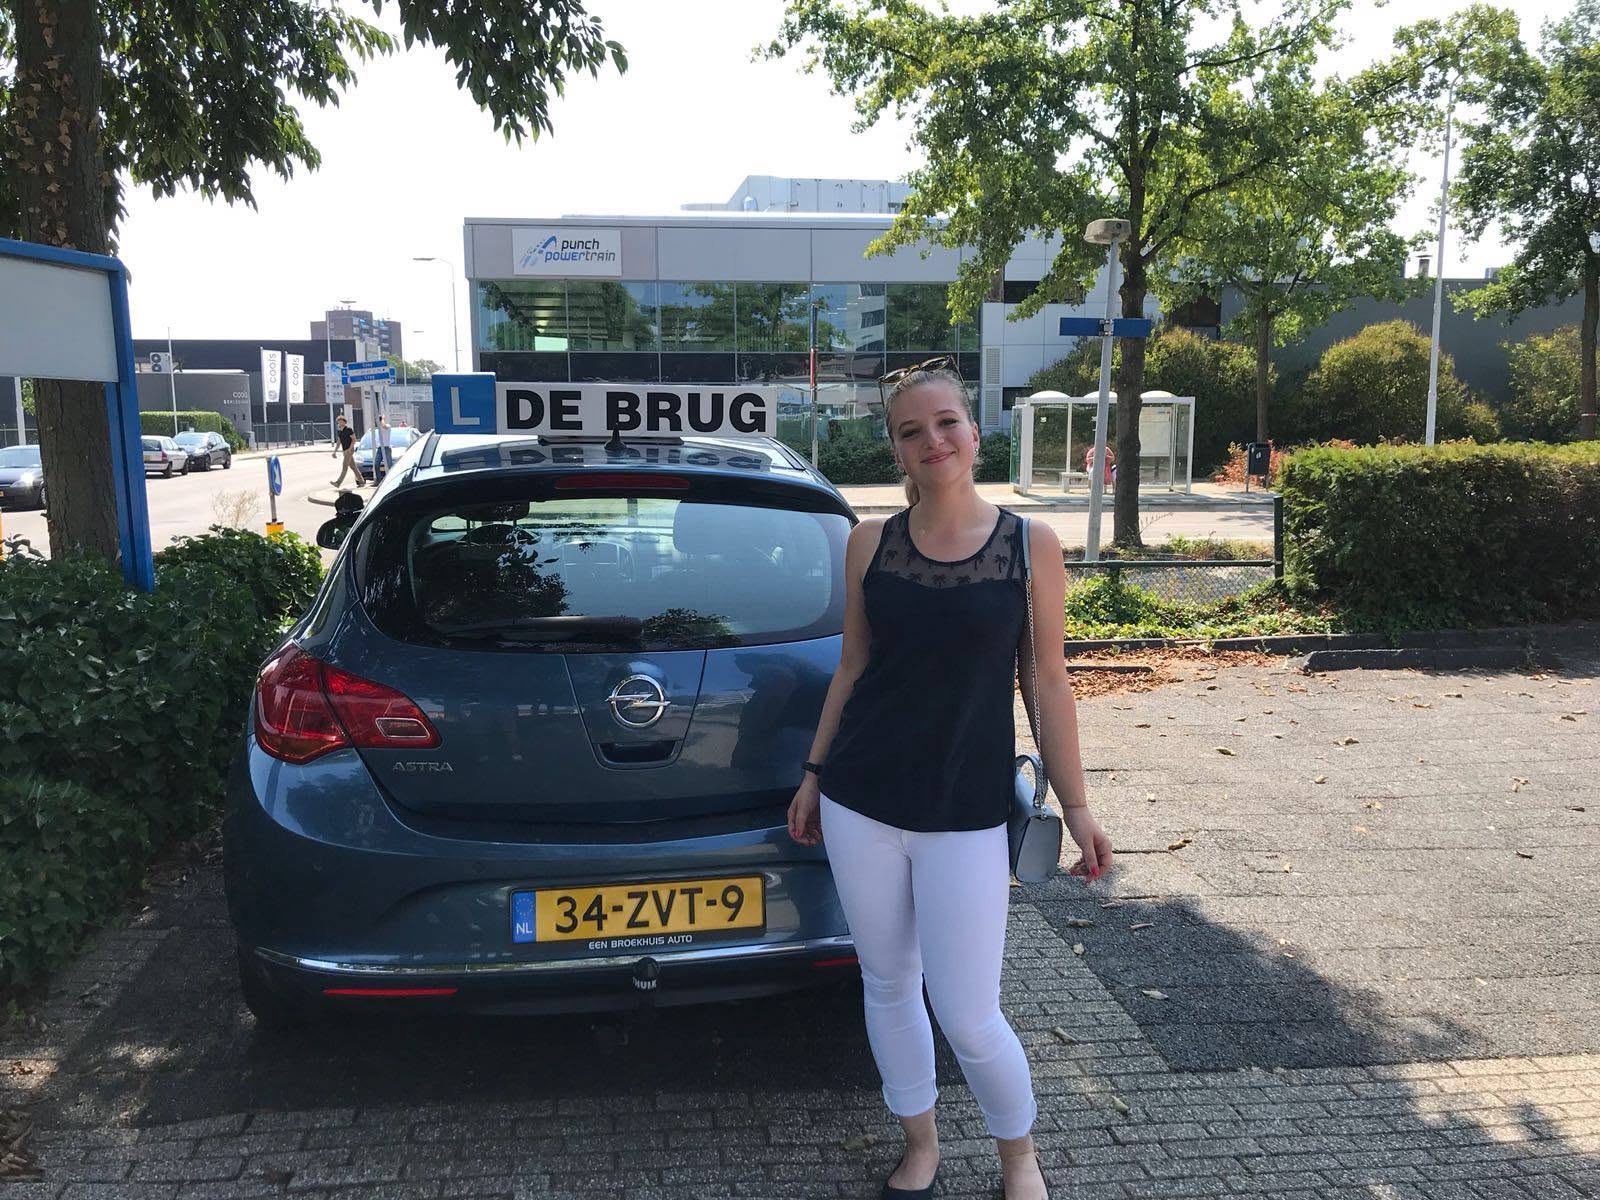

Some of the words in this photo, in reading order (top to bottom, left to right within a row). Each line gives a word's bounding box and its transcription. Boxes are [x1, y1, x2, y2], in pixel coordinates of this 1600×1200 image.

[561, 238, 600, 251] punch
[268, 353, 277, 384] cools
[291, 357, 300, 386] cools
[450, 386, 480, 426] L
[505, 389, 583, 430] DE
[606, 391, 767, 433] BRUG
[392, 761, 454, 772] ASTRA
[555, 885, 745, 934] 34-ZVT-9
[516, 922, 533, 935] NL
[588, 940, 608, 950] EEN
[611, 936, 665, 949] BROEKHUIS
[667, 934, 693, 944] AUTO
